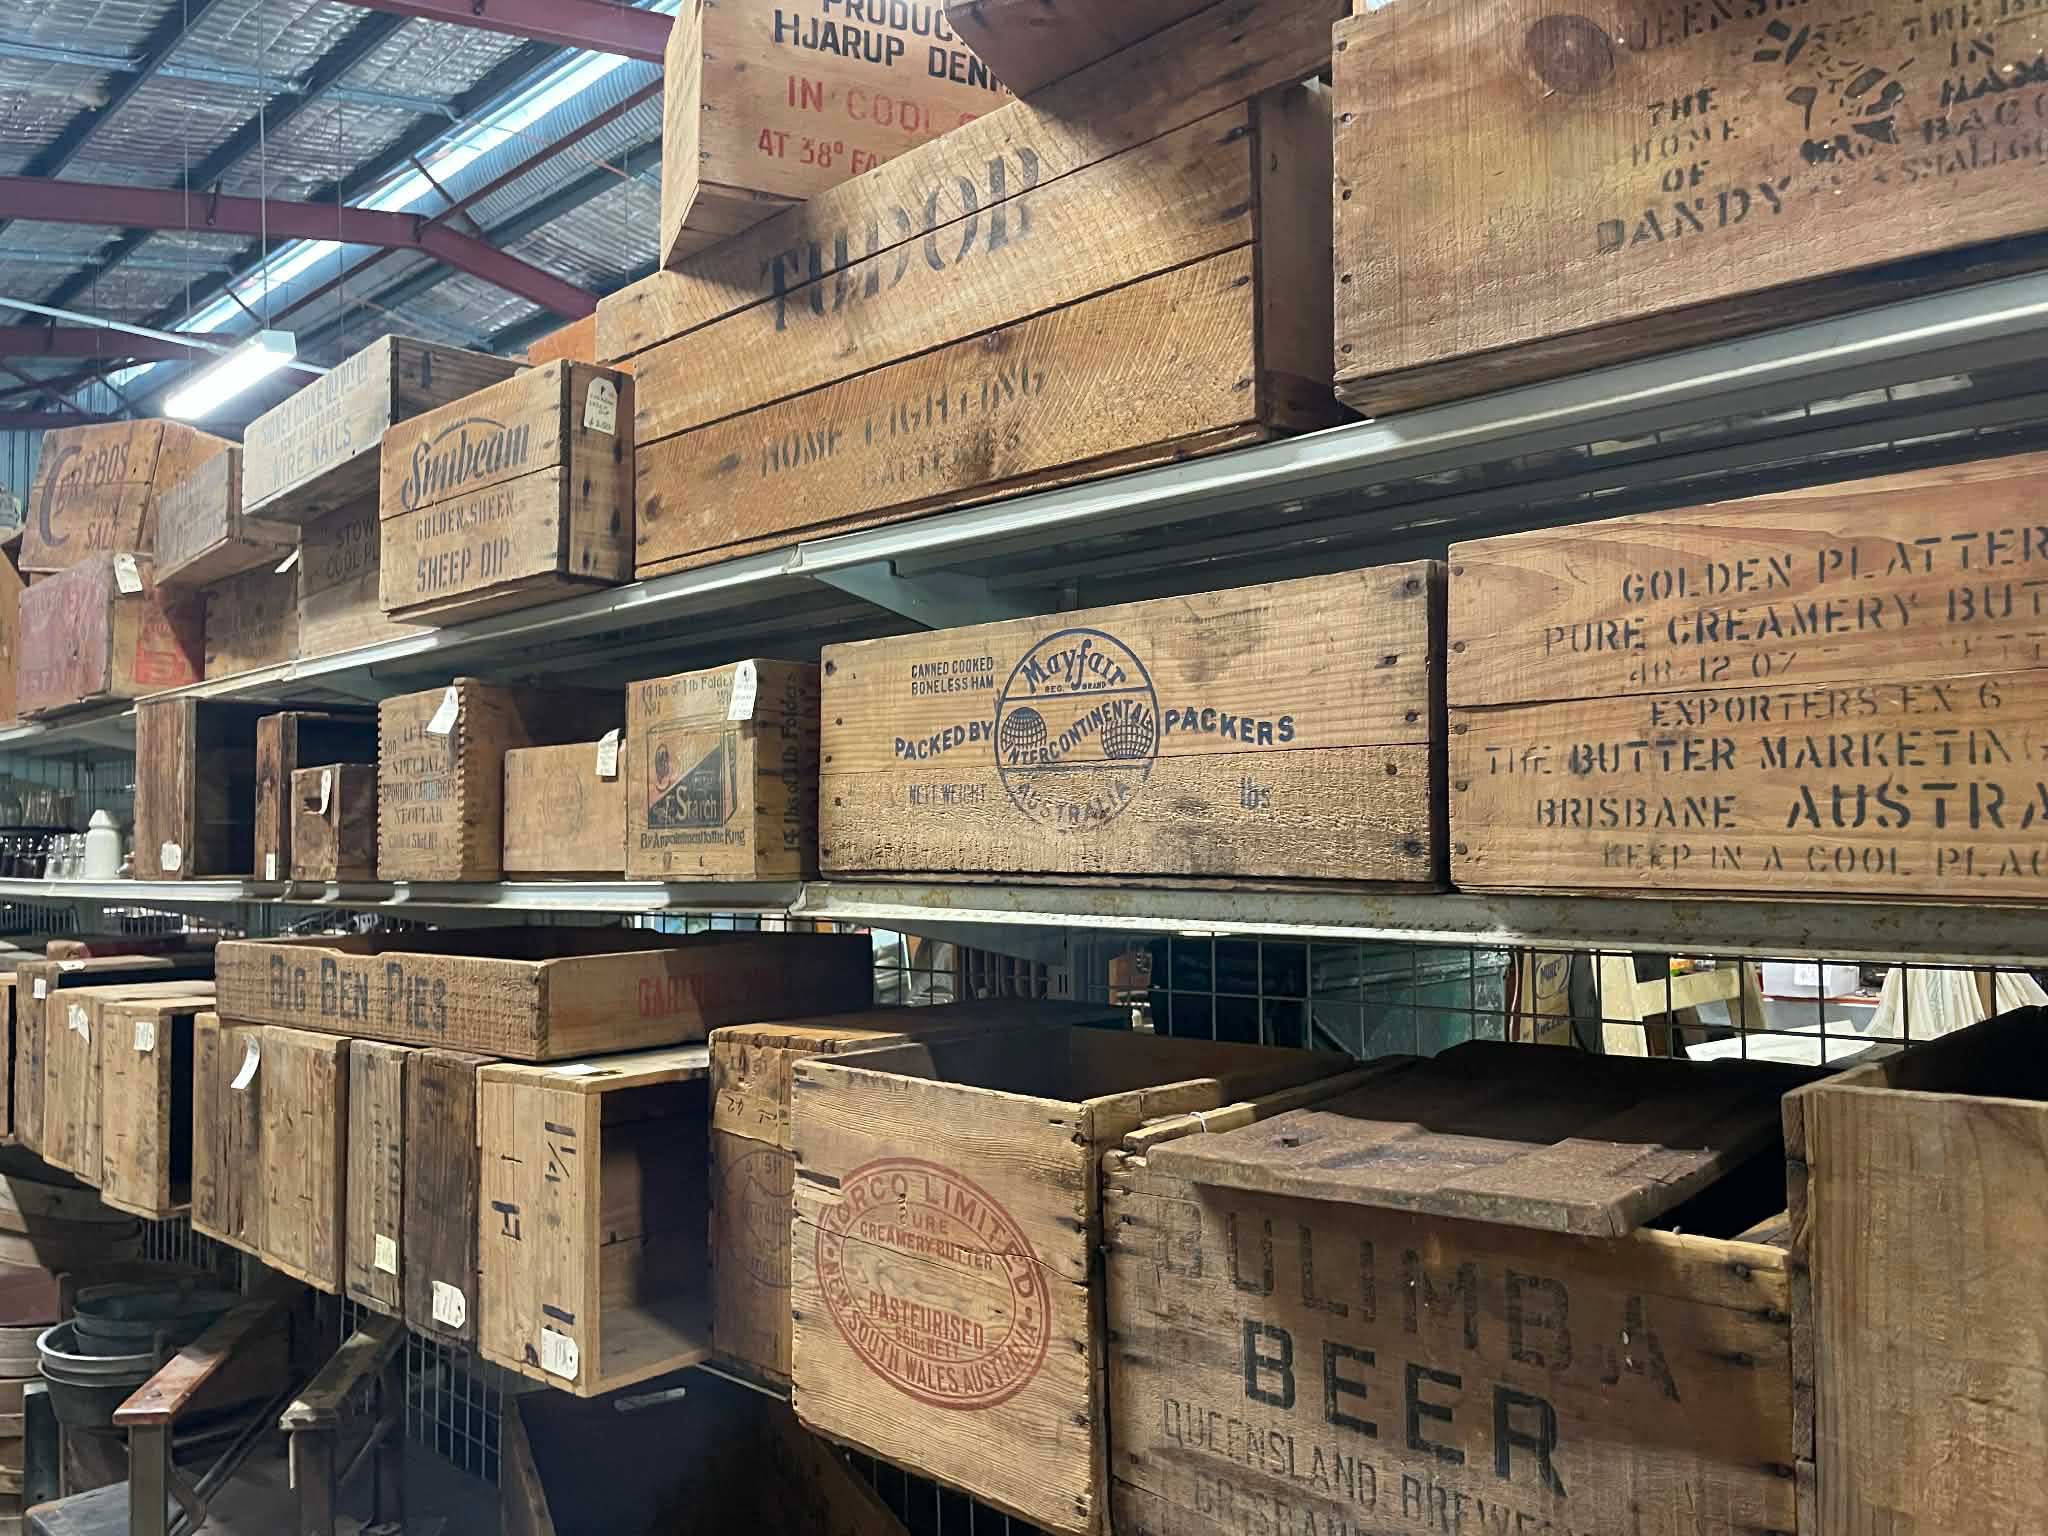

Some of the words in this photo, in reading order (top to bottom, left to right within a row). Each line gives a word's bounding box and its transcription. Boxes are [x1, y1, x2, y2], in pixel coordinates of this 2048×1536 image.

[774, 9, 905, 66] HJARUP
[788, 75, 824, 113] IN
[1647, 87, 1718, 127] THE
[758, 128, 790, 158] AT
[1632, 116, 1740, 167] HOME
[1661, 160, 1711, 193] OF
[760, 146, 1040, 332] TUDOR
[1596, 176, 1792, 252] DANDY
[273, 446, 305, 489] WIRE
[312, 420, 352, 467] NAILS
[401, 423, 530, 512] Sunbeam
[760, 424, 842, 479] HOME
[415, 504, 465, 543] GOLDEN
[416, 545, 471, 593] SHEEP
[480, 536, 511, 578] DIP
[1622, 554, 1792, 603] GOLDEN
[1818, 526, 2048, 584] PLATTER
[1543, 617, 1648, 657] PURE
[1667, 592, 1918, 645] CREAMERY
[911, 677, 968, 696] BONELESS
[971, 674, 994, 690] HAM
[912, 661, 949, 679] CANNED
[952, 657, 994, 674] COOKED
[1020, 638, 1127, 694] Mayfair
[1001, 699, 1153, 765] INTERCONTINENTAL
[1165, 706, 1296, 746] PACKERS
[1651, 687, 1879, 727] EXPORTERS
[1902, 684, 1953, 715] EX
[895, 725, 966, 760] PACKED
[969, 720, 994, 742] BY
[1485, 744, 1553, 775] THE
[1567, 737, 1737, 776] BUTTER
[942, 783, 986, 805] WEIGHT
[1536, 796, 1738, 829] BRISBANE
[1786, 781, 2048, 830] AUSTRA
[1602, 843, 1692, 872] KEEP
[1711, 845, 1743, 871] IN
[1763, 846, 1784, 872] A
[1807, 846, 1912, 876] COOL
[269, 953, 307, 1012] BIG
[320, 957, 369, 1021] BEN
[383, 961, 449, 1031] PIES
[824, 1172, 910, 1249] NORCO
[924, 1174, 1035, 1299] LIMITED
[859, 1220, 936, 1254] CREAMERY
[936, 1238, 993, 1271] BUTTER
[821, 1262, 850, 1312] NEW
[849, 1311, 900, 1373] SOUTH
[905, 1352, 960, 1394] WALES
[963, 1316, 1038, 1395] AUSTRALIA
[868, 1290, 985, 1351] PASTEURISED
[1242, 1318, 1568, 1499] BEER
[1162, 1397, 1378, 1507] QUEENSLAND
